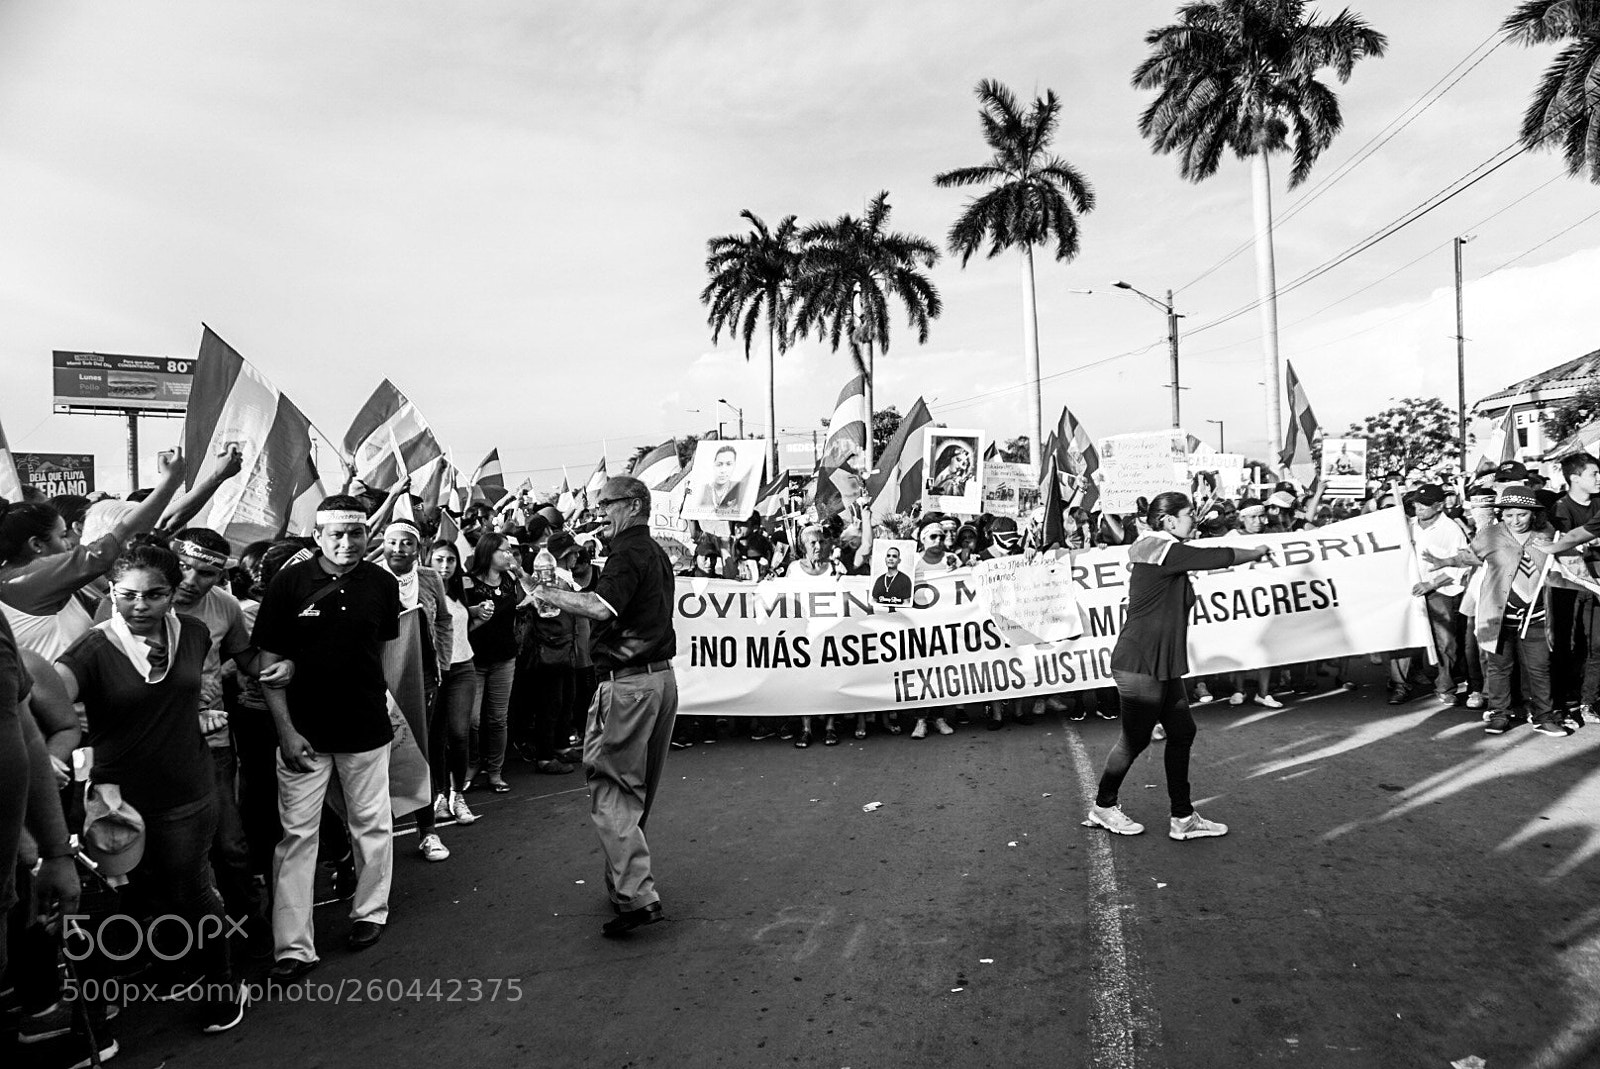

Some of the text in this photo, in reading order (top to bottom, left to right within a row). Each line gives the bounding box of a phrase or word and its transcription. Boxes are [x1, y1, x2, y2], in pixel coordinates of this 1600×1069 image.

[166, 360, 188, 373] 80
[79, 373, 102, 381] Lunes
[79, 383, 100, 391] Pollo
[1188, 455, 1238, 467] CARAGUA
[47, 471, 63, 482] QUE
[63, 470, 85, 481] FLUYA
[672, 583, 941, 618] OVIMIENO
[690, 635, 738, 668] ¡NO
[746, 630, 810, 669] MÁS
[1192, 577, 1340, 626] ASACRES!
[893, 646, 1113, 703] ¡EXIGIMOS JUSTIC
